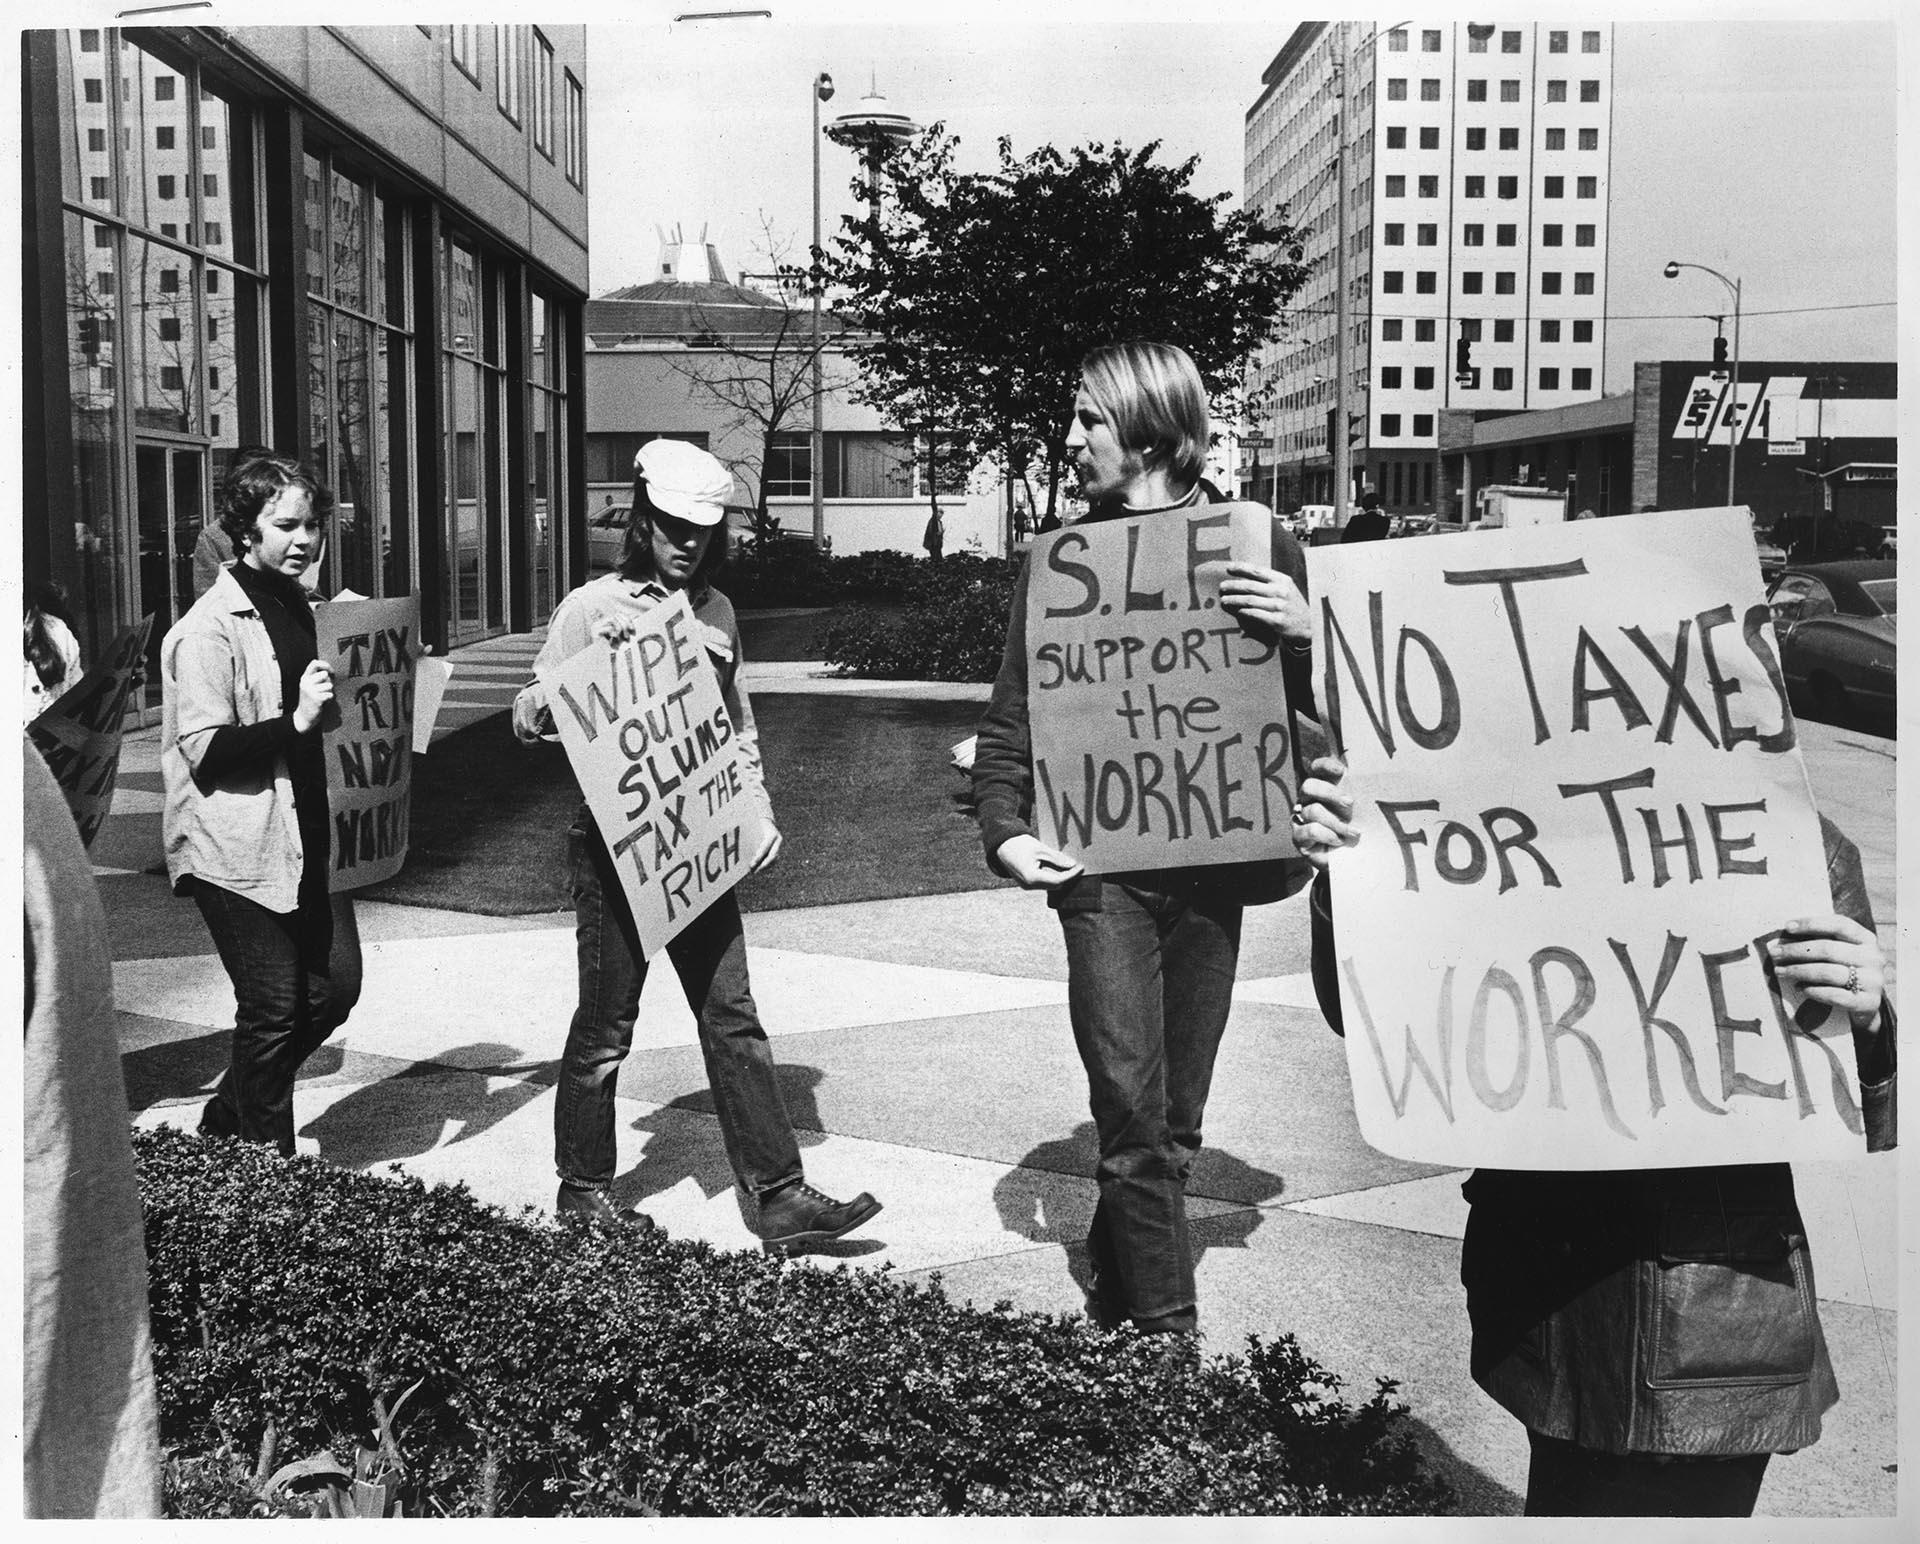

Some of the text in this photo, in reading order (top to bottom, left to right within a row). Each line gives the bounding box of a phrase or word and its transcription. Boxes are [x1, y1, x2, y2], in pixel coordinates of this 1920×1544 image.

[1044, 512, 1231, 619] S.L.F.
[337, 626, 412, 678] TAX
[558, 609, 699, 743] WIPE
[1036, 627, 1277, 690] SUPPORTS
[1321, 557, 1796, 759] NO TAXES
[618, 706, 732, 822] SLUMS
[619, 682, 695, 762] OUT
[1116, 684, 1221, 740] the
[613, 760, 742, 886] TAX THE
[1035, 722, 1299, 851] WORKER
[1375, 767, 1768, 896] FOR THE
[660, 826, 741, 922] RICH
[1341, 929, 1865, 1140] WORKER
